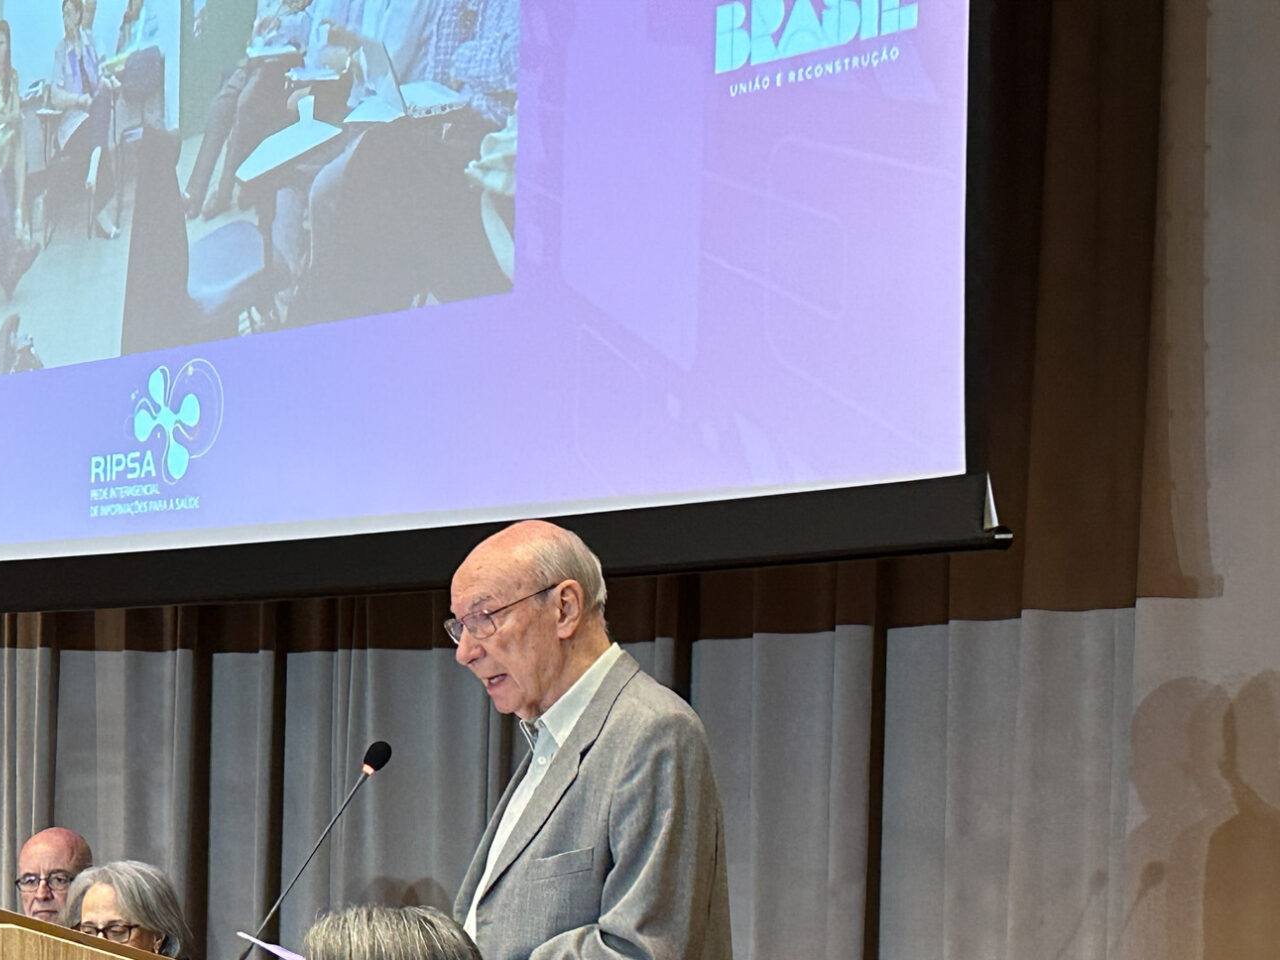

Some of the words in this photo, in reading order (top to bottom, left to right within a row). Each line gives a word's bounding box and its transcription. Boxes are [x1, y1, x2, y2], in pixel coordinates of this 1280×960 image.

[715, 0, 918, 74] BRASIL
[729, 75, 770, 97] UNIÃO
[775, 73, 782, 87] E
[788, 45, 900, 84] RECONSTRUÇÃO
[91, 450, 156, 483] RIPSA
